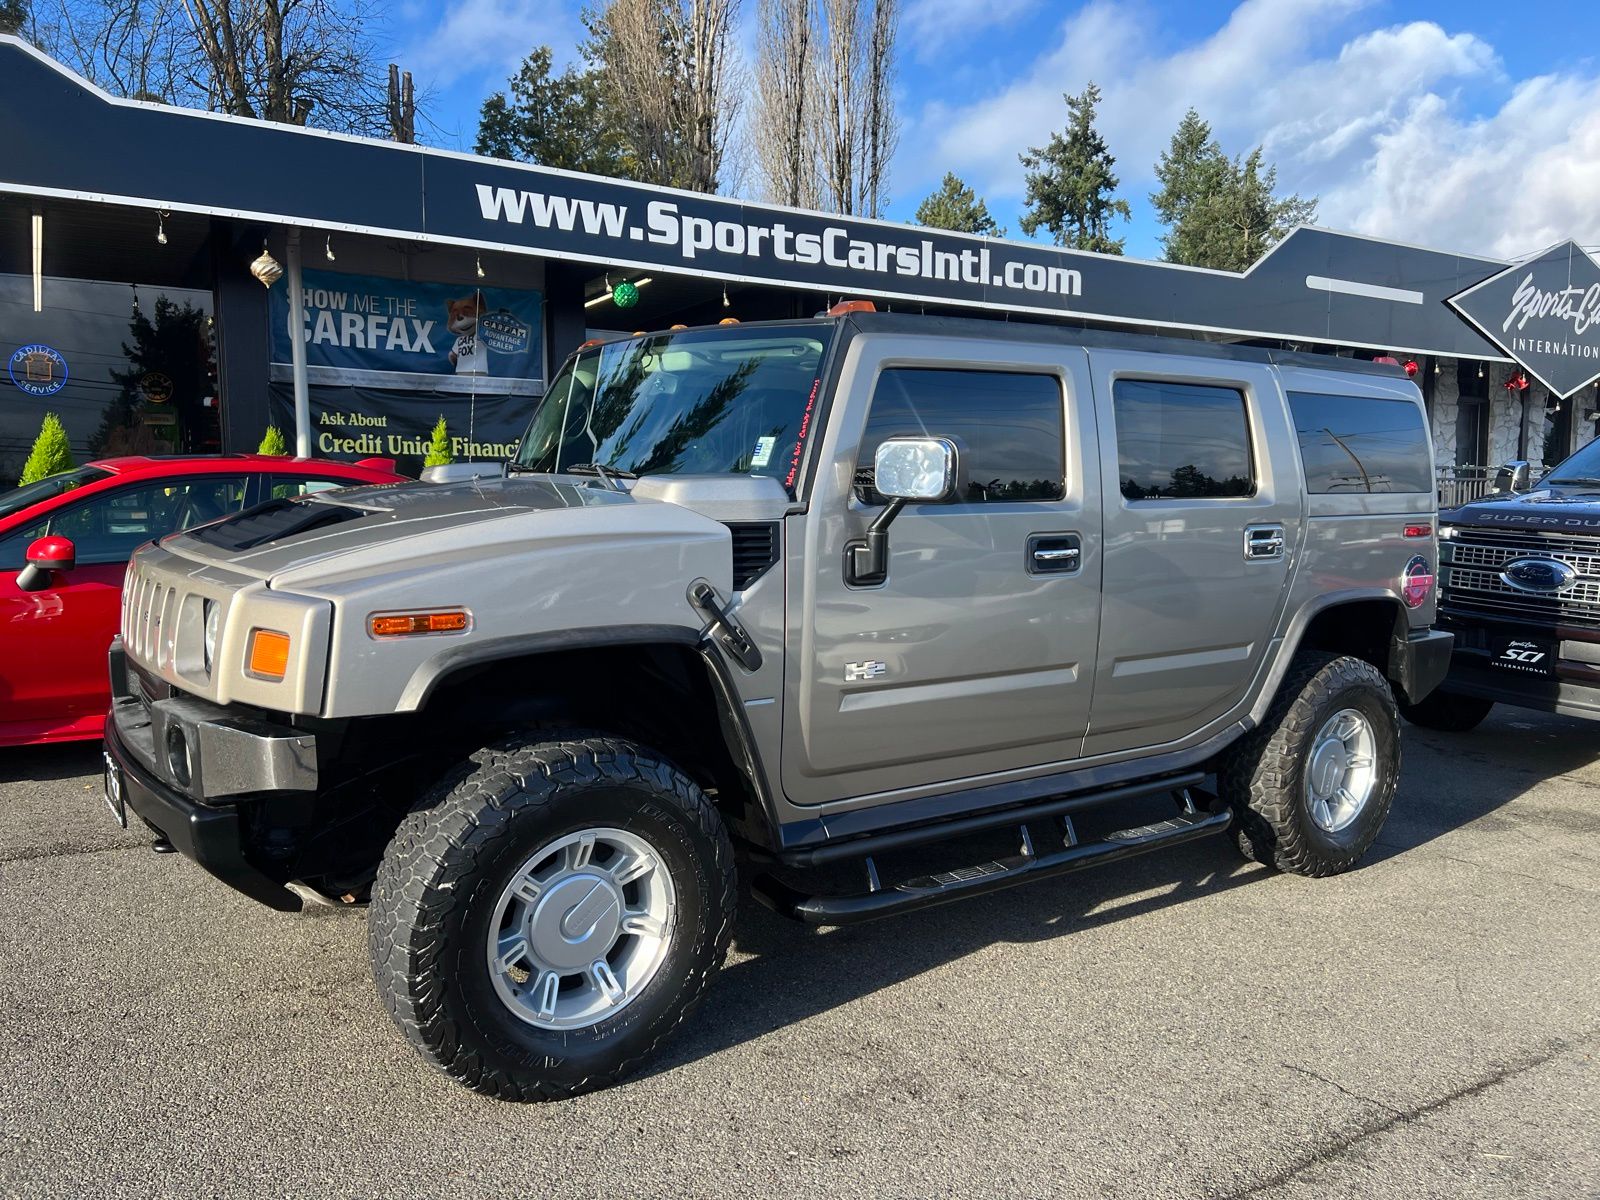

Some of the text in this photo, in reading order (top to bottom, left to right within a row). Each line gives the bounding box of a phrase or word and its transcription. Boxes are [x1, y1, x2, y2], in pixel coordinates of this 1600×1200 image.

[475, 183, 1082, 297] www.SportsCarsIntl.com
[353, 293, 380, 314] ME
[384, 296, 417, 318] THE
[1503, 272, 1584, 333] Sports
[287, 309, 436, 354] CARFAX
[483, 320, 526, 338] CARFAX
[484, 329, 521, 346] ADVANTAGE
[457, 345, 474, 357] FOX
[488, 339, 514, 351] DEALER
[1512, 337, 1600, 358] INTERNATION
[14, 345, 61, 365] CADILLAC
[20, 380, 61, 394] SERVICE
[319, 411, 388, 427] Ask About
[318, 432, 383, 454] Credit
[387, 434, 432, 456] Unio
[1478, 513, 1559, 525] SUPER
[1499, 648, 1546, 663] SCI
